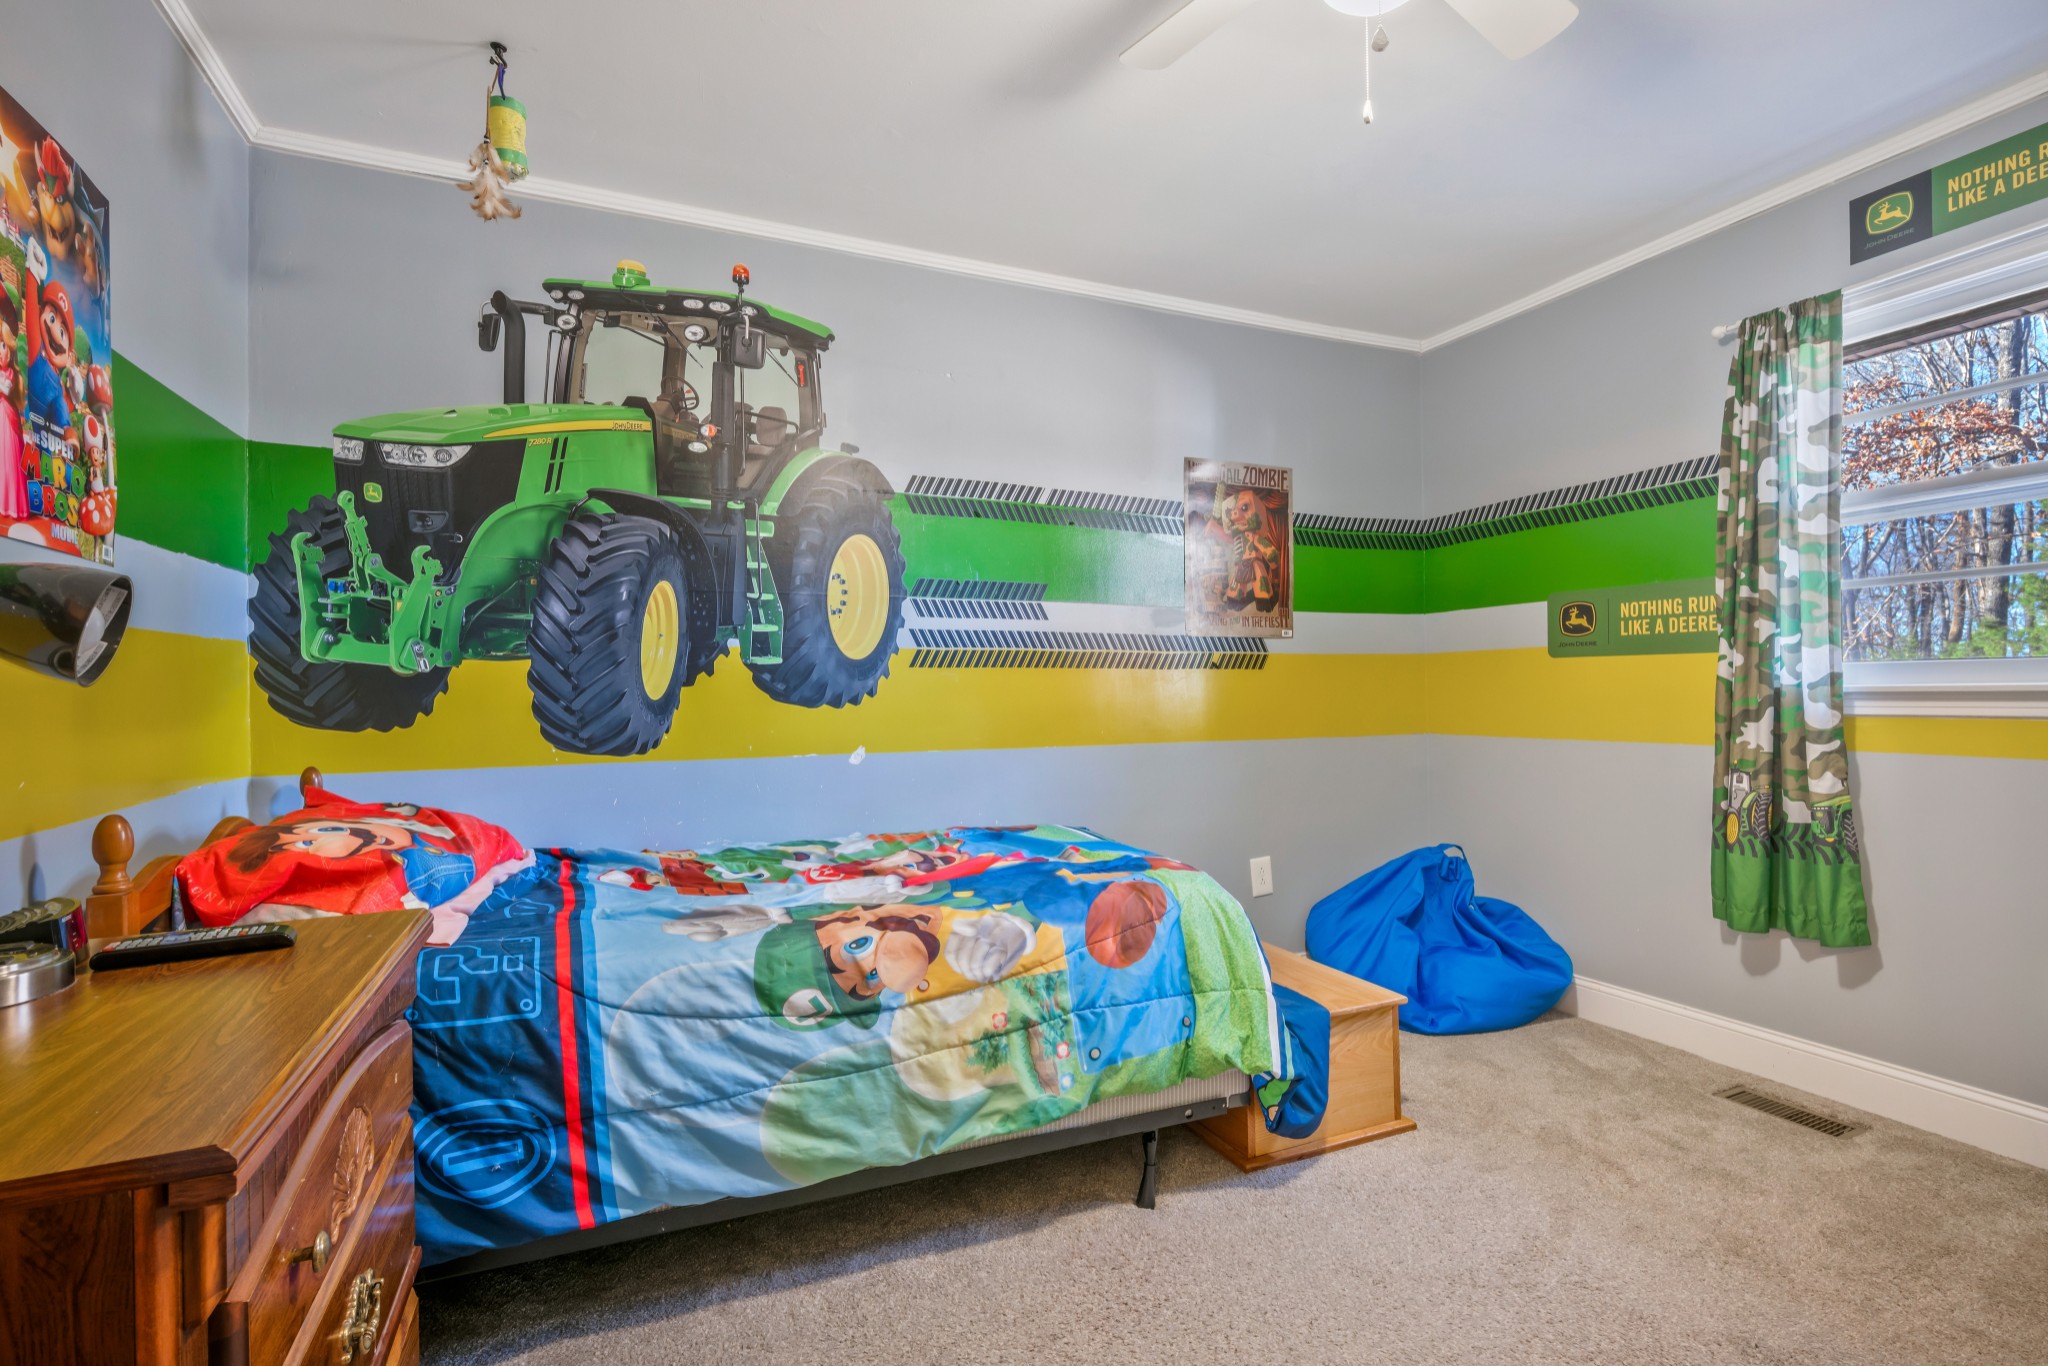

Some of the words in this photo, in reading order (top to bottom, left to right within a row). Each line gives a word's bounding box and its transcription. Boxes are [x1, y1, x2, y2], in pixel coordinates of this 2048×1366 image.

[1947, 149, 2031, 194] NOTHING
[1947, 183, 1988, 213] LIKE
[1993, 178, 2006, 196] A
[1864, 237, 1886, 249] JOHN
[1886, 227, 1915, 241] DEERE
[611, 421, 626, 430] JOHN
[40, 429, 74, 461] SUPER
[20, 442, 86, 498] MARIO
[1226, 467, 1241, 484] ALL
[1241, 465, 1288, 492] ZOMBIE
[51, 522, 79, 546] MOVIE
[1620, 598, 1683, 618] NOTHING
[1620, 618, 1651, 637] LIKE
[1655, 617, 1665, 634] A
[1668, 613, 1718, 634] DEERE
[1558, 641, 1575, 649] JOHN
[1575, 640, 1598, 648] DEERE
